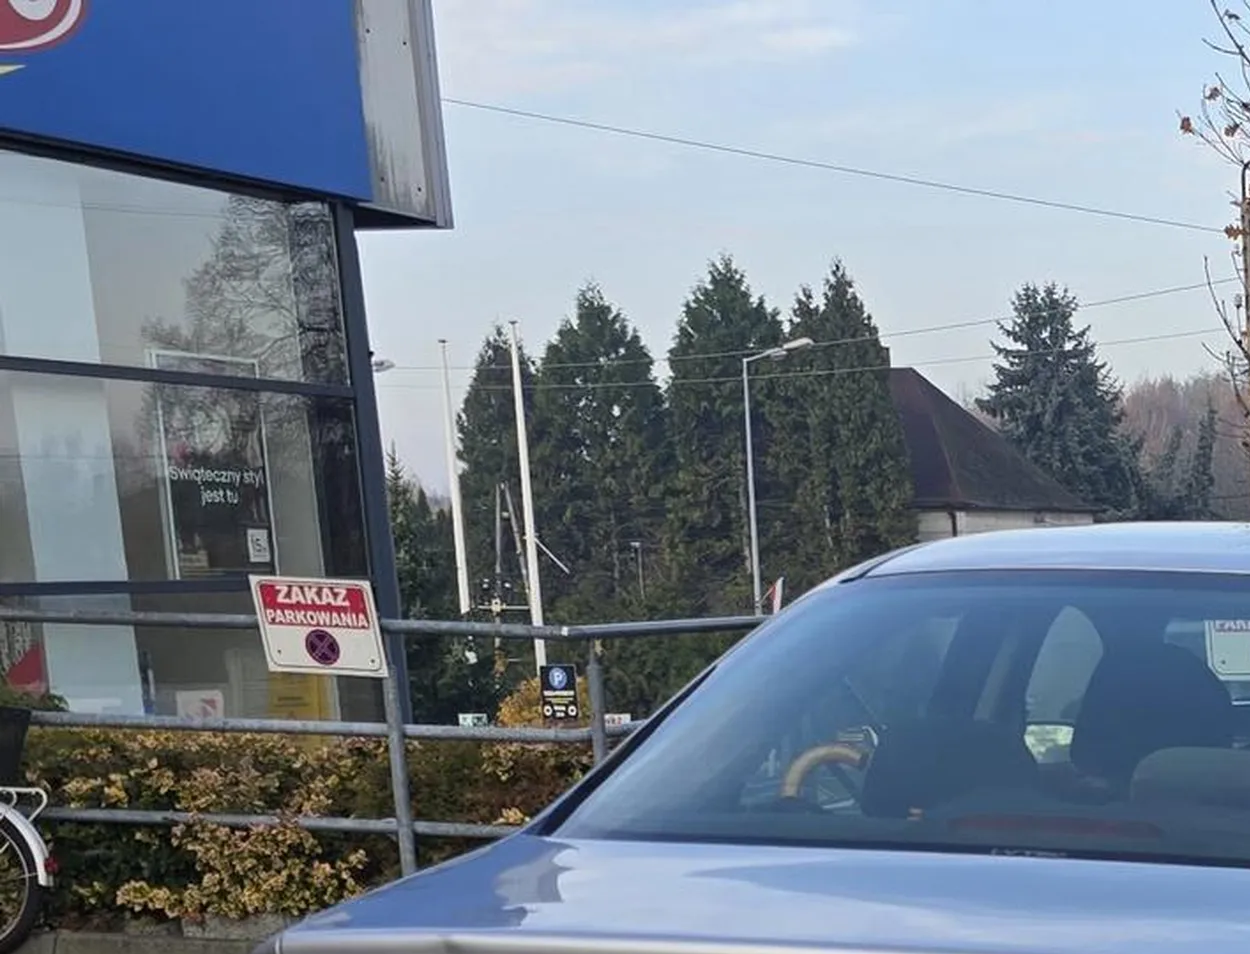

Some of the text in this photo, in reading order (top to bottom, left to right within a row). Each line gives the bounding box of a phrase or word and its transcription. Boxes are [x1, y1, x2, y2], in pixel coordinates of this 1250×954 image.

[200, 486, 239, 507] jest tu
[274, 585, 350, 606] ZAKAZ
[266, 609, 368, 627] PARKOWANIA
